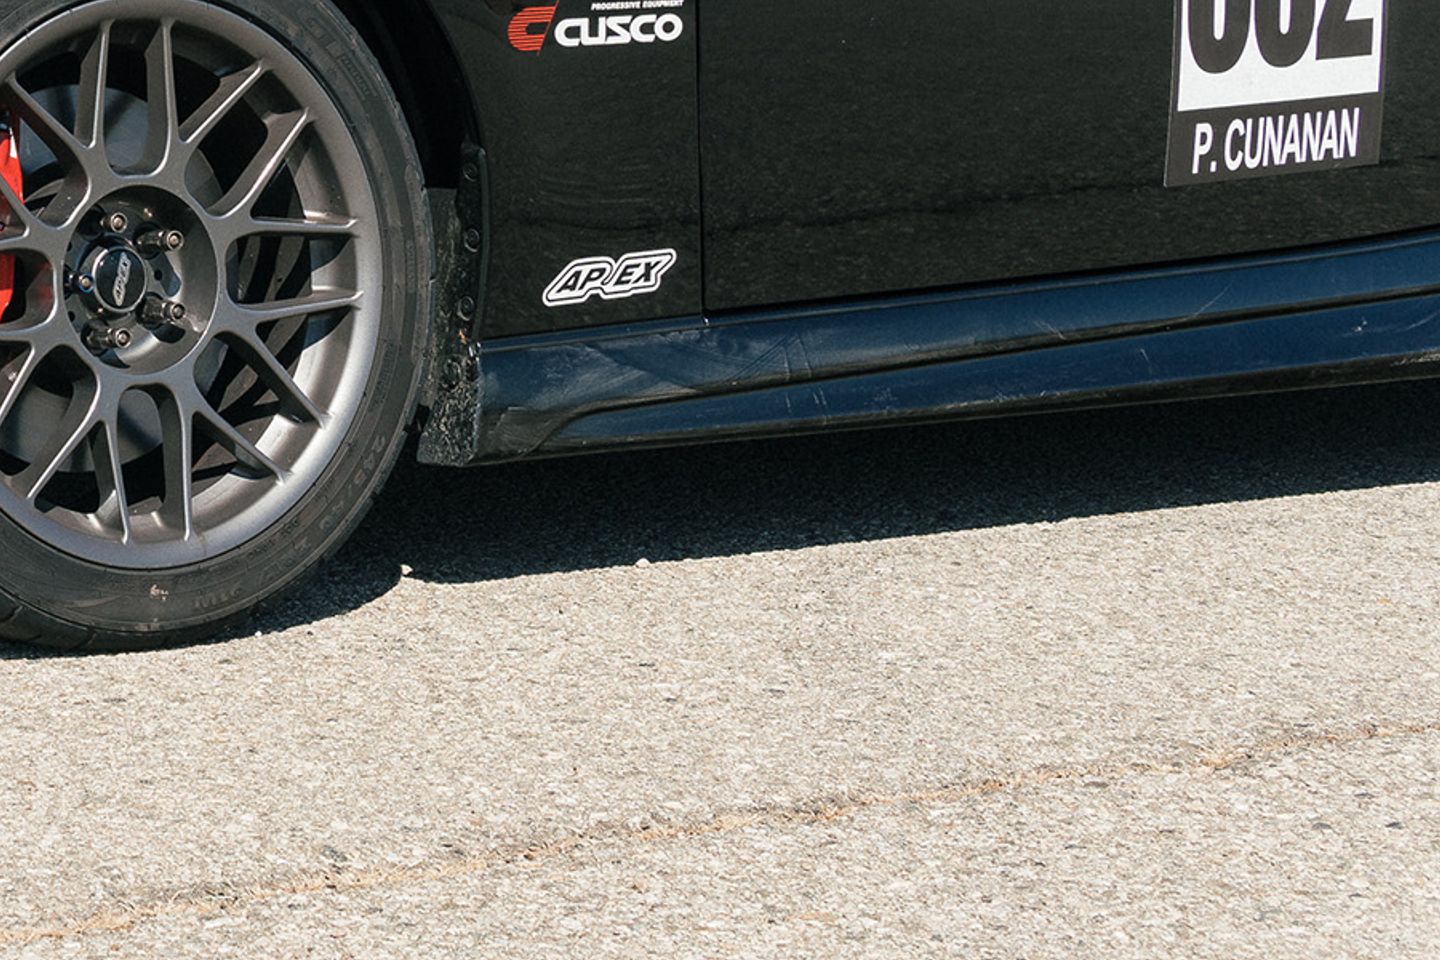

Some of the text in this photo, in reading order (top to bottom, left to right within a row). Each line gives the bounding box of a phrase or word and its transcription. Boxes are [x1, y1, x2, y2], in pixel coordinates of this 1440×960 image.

[554, 13, 684, 48] CUSCO
[1191, 107, 1360, 175] P. CUNANAN
[550, 255, 669, 298] APEX
